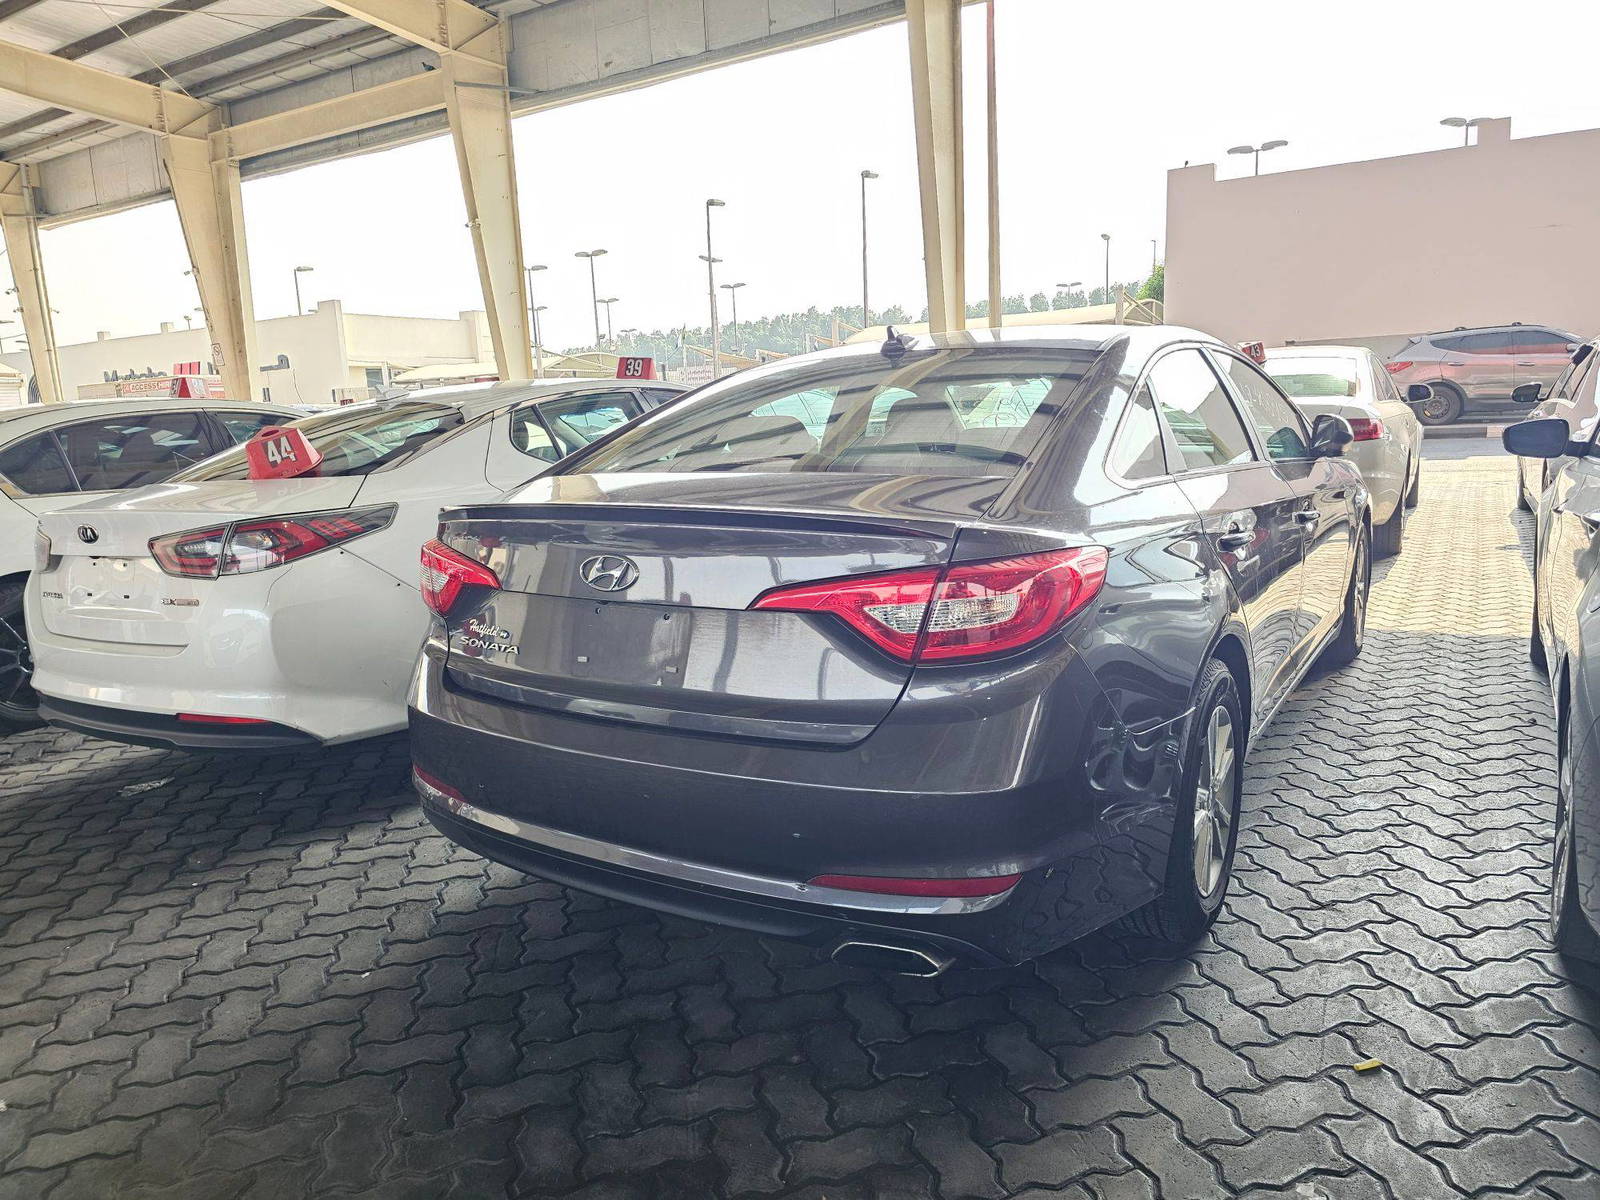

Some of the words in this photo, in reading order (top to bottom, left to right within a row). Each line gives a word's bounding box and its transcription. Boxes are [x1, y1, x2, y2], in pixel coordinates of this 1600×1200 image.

[1250, 344, 1261, 358] 43
[625, 358, 643, 377] 39
[267, 435, 297, 464] 44
[469, 618, 500, 637] Hatfield
[459, 636, 520, 655] SONATA
